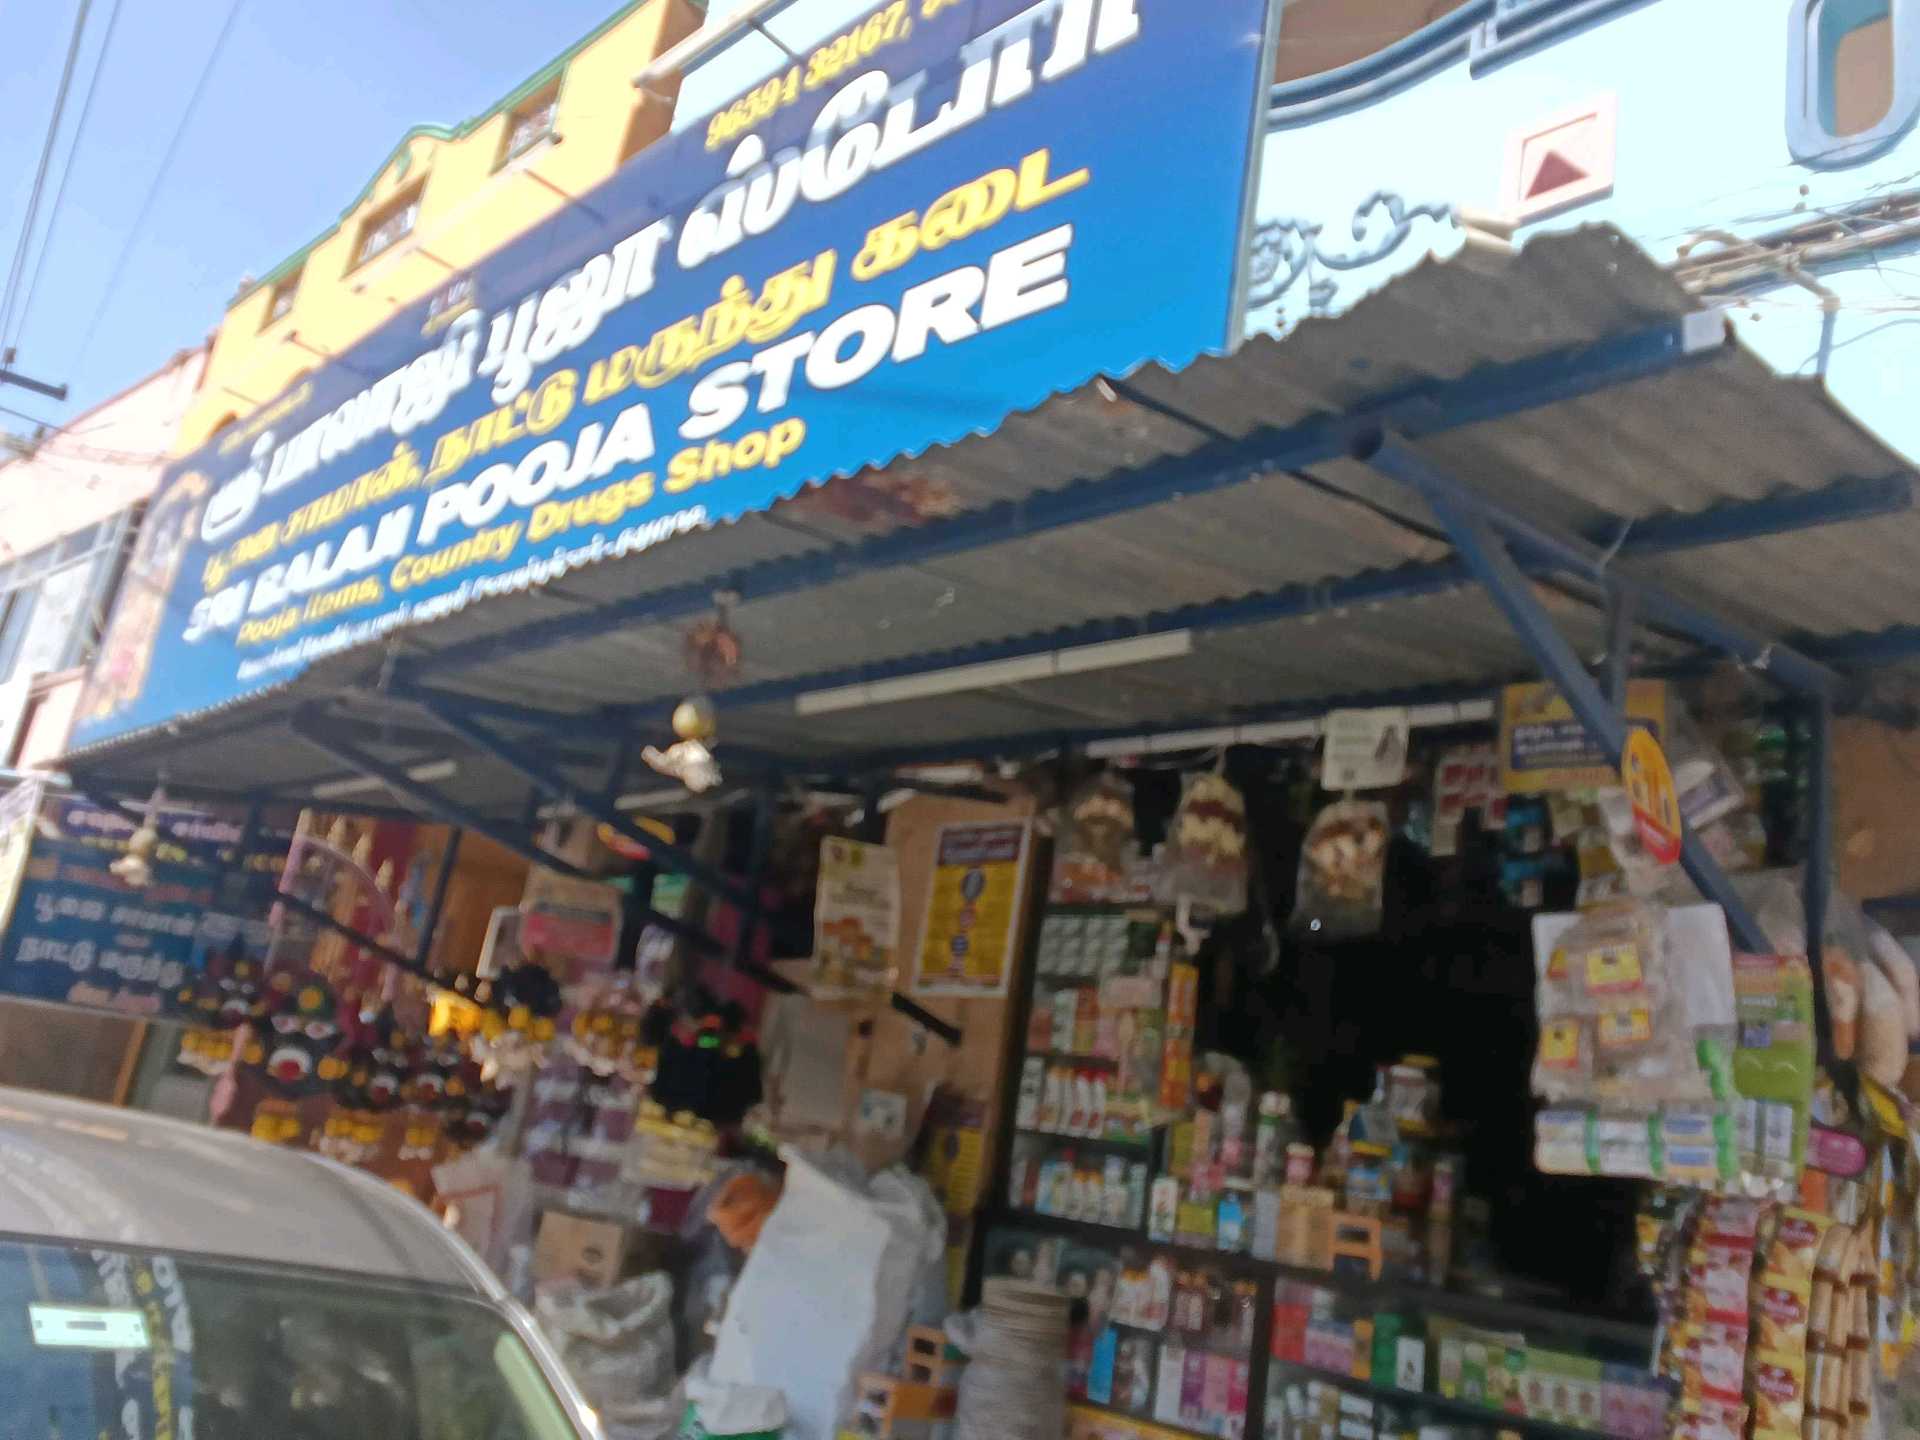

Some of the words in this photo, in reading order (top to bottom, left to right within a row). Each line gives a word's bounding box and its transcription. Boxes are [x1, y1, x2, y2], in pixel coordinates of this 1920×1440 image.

[181, 578, 251, 644] SRI
[247, 503, 415, 615] BALAJI
[417, 402, 656, 547] POOJA
[678, 222, 1074, 441] STORE
[262, 306, 485, 494] பாலாஜி
[477, 214, 673, 405] பூஜா
[421, 368, 579, 487] நாட்டு
[582, 247, 838, 406] மருந்து
[851, 147, 1091, 283] கடை
[236, 605, 300, 647] Pooja
[390, 520, 524, 592] Country
[527, 472, 656, 542] Drugs
[663, 417, 806, 493] Shop
